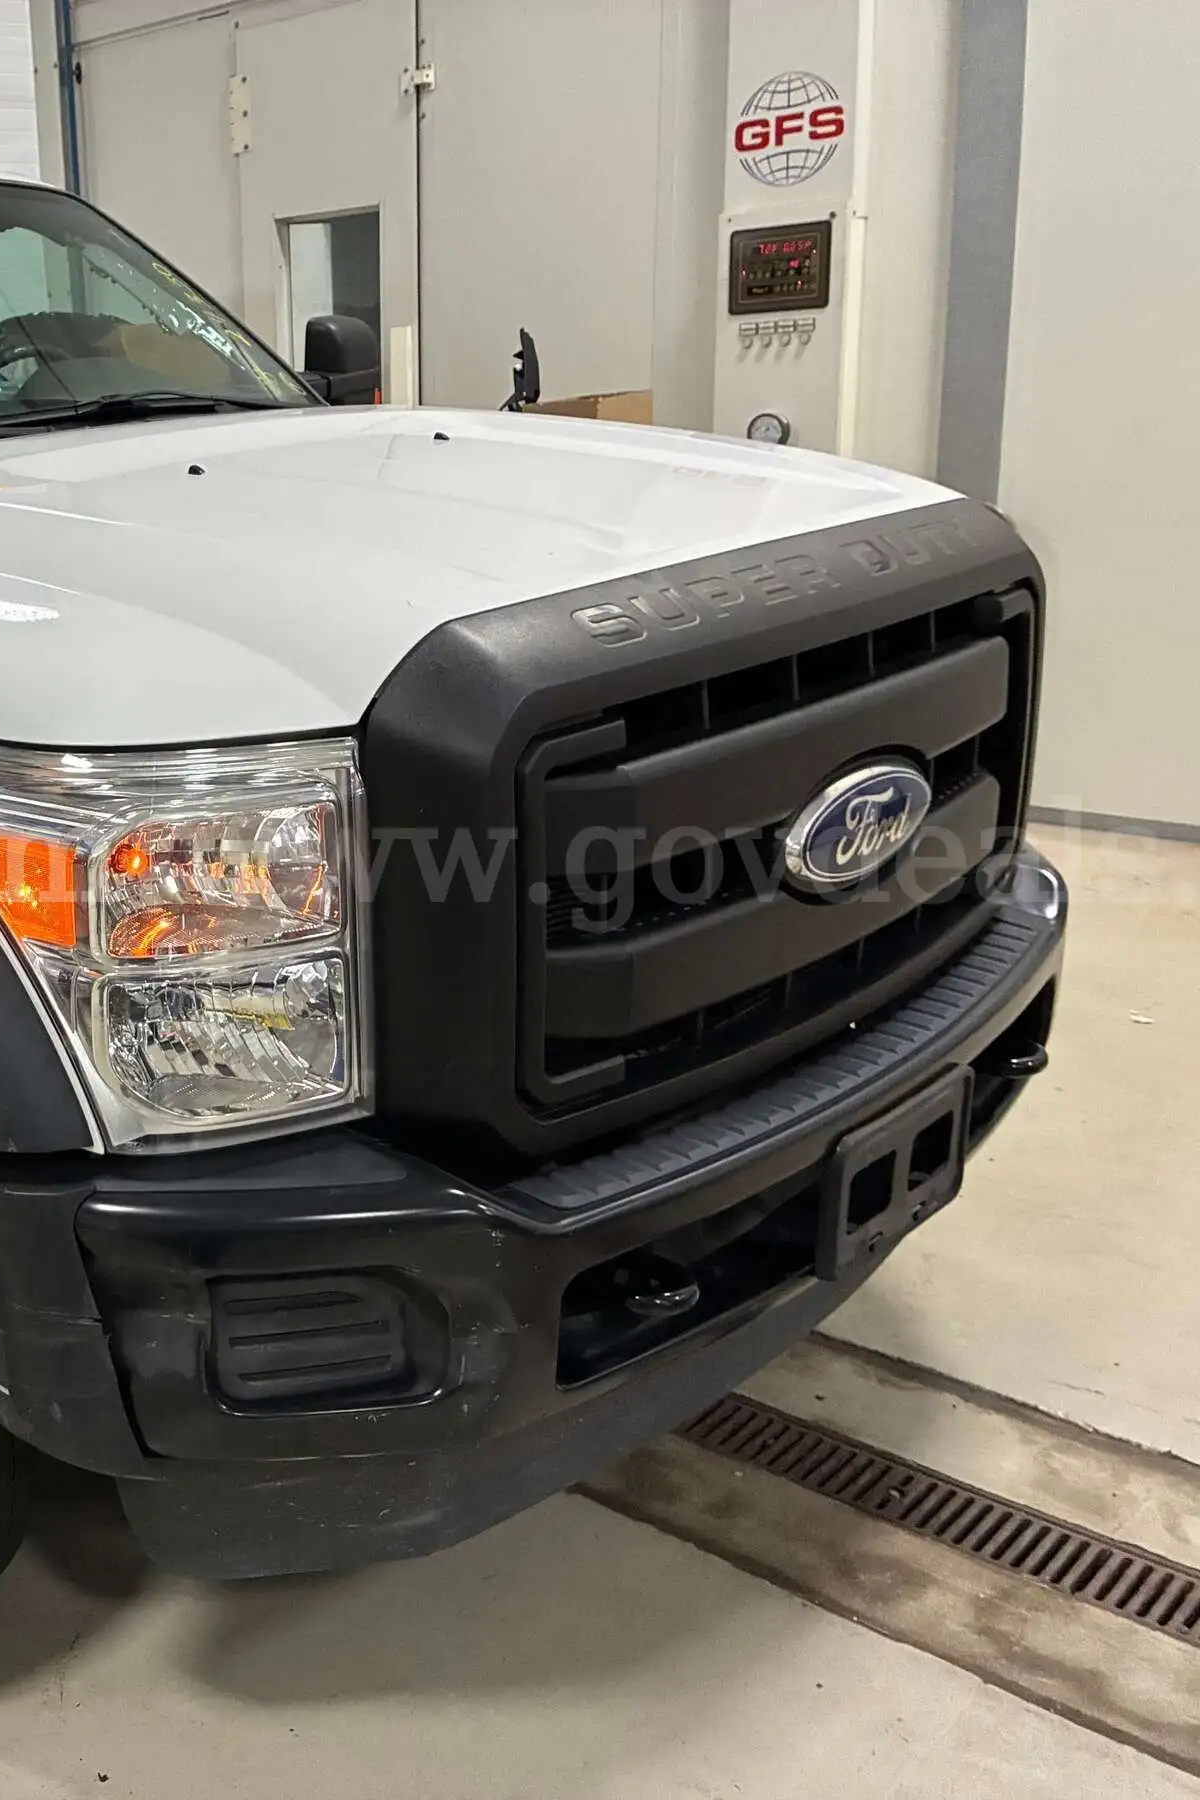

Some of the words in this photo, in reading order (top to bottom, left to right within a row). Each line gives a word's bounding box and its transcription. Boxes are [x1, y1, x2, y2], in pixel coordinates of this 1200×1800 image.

[734, 105, 845, 152] GFS
[570, 554, 843, 648] SUPER
[838, 515, 980, 576] DUTY
[835, 786, 913, 866] Ford
